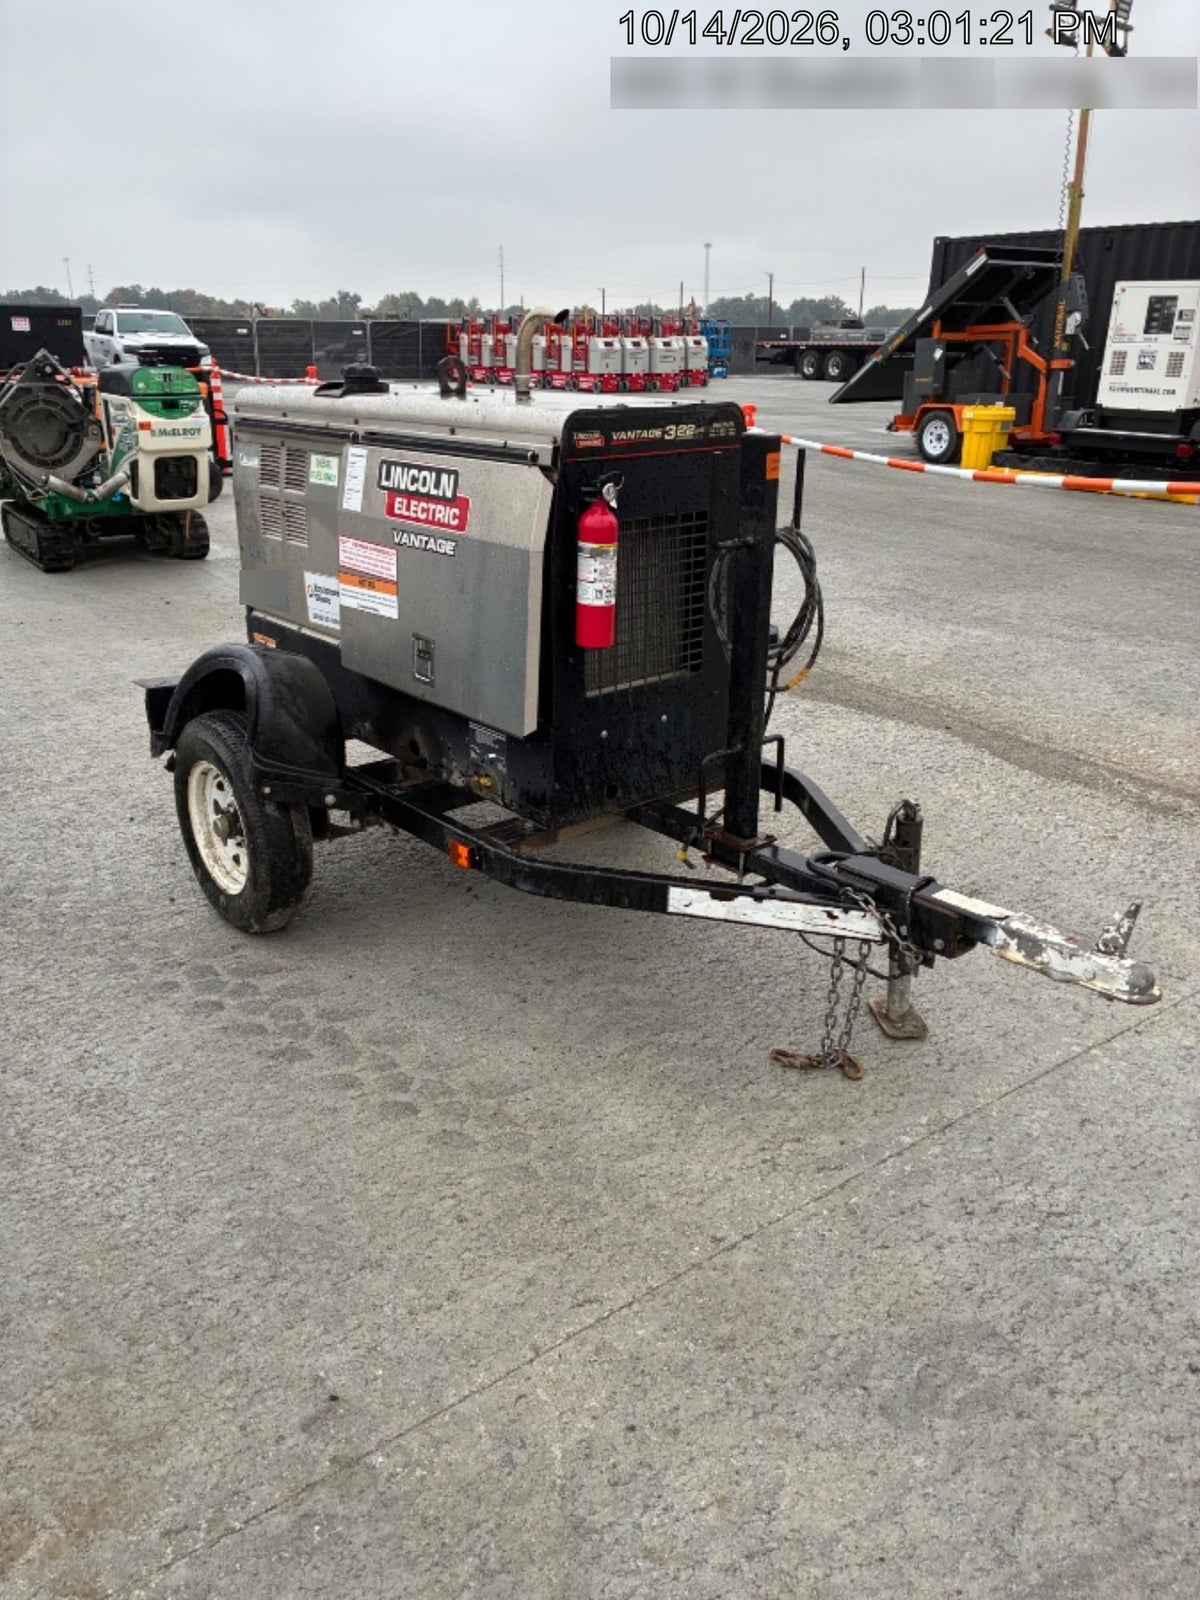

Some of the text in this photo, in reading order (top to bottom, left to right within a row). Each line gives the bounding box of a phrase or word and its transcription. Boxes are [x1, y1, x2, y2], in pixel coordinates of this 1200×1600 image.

[613, 429, 662, 440] VANTAGE
[380, 464, 454, 498] LINCOLN
[394, 497, 460, 526] ELECTRIC
[392, 529, 457, 556] VANTAGE
